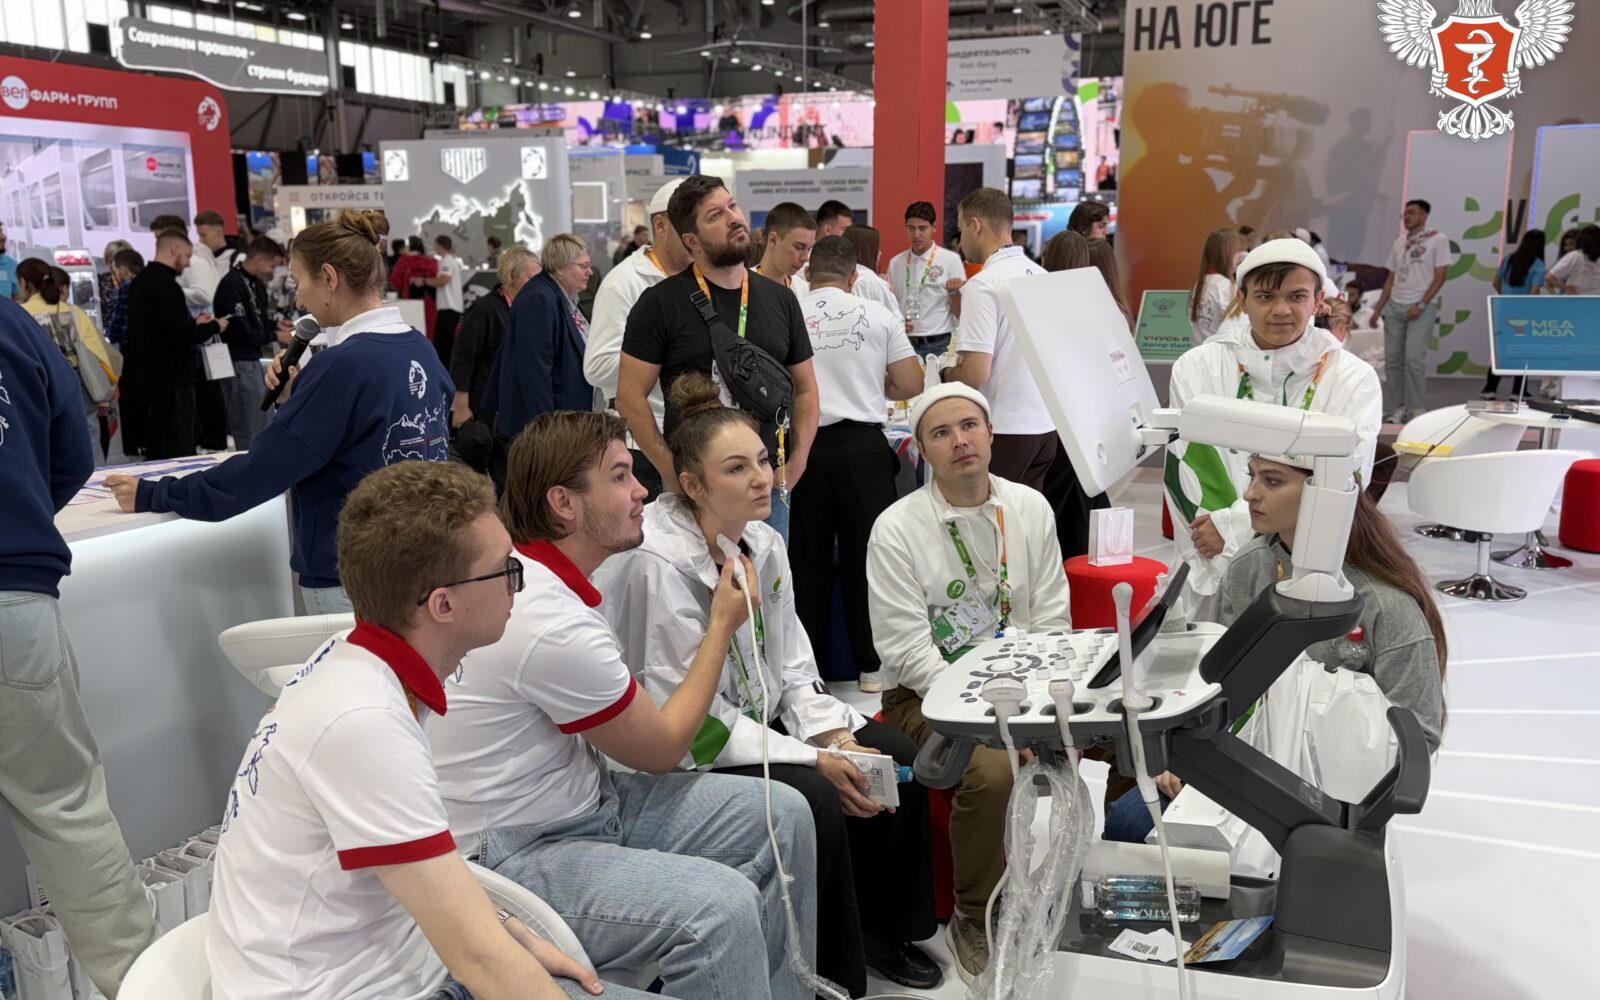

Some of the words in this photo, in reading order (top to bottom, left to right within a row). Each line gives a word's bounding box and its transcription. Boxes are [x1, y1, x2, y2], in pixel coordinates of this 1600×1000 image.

[1134, 5, 1181, 51] НА
[1194, 0, 1274, 48] ЮГЕ
[128, 26, 196, 52] Сохраняем
[198, 40, 248, 59] прошлое
[247, 64, 286, 80] строим
[286, 67, 330, 87] будущее
[310, 190, 369, 202] ОТКРОЙСЯ
